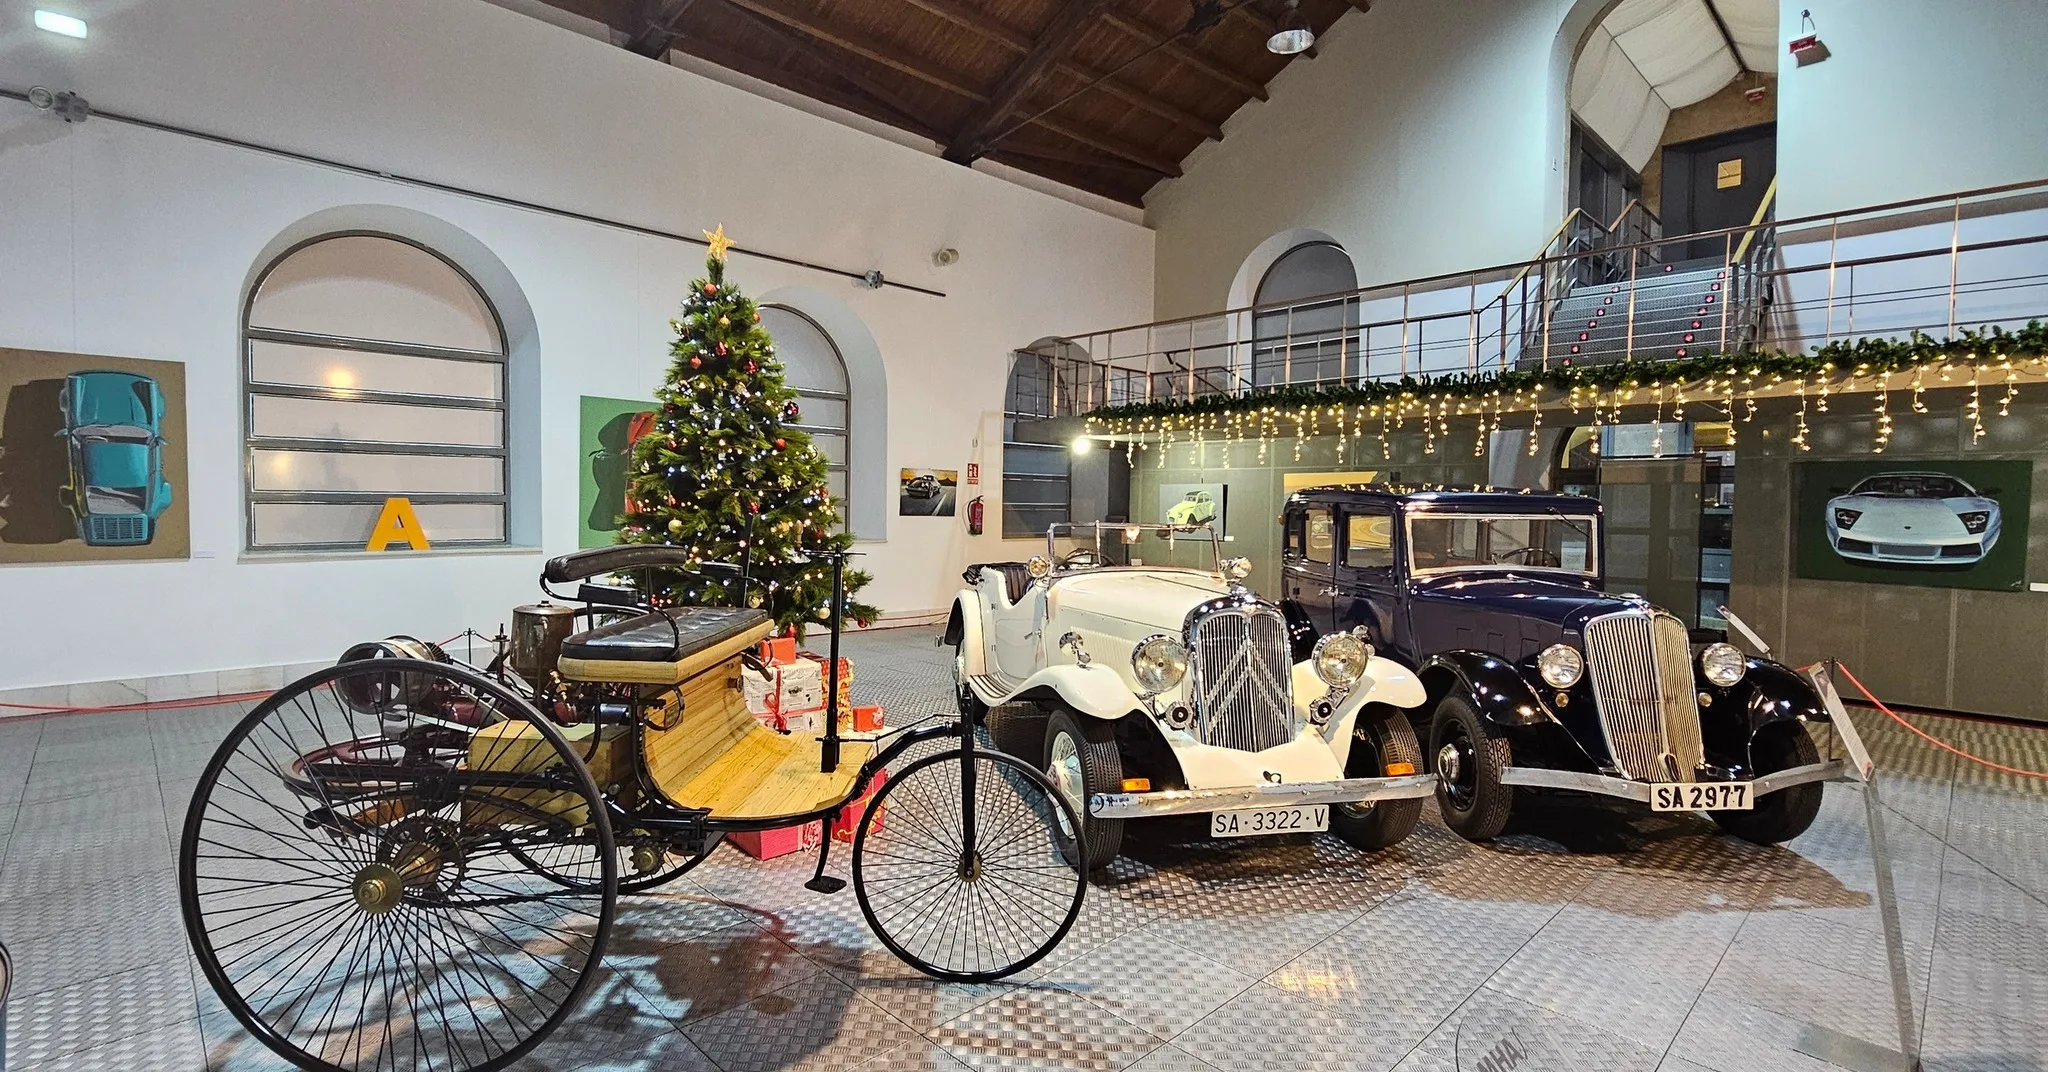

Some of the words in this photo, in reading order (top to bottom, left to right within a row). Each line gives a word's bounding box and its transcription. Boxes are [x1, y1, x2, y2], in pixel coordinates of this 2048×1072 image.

[365, 497, 431, 552] A
[1657, 786, 1684, 809] SA
[1689, 785, 1747, 809] 2977
